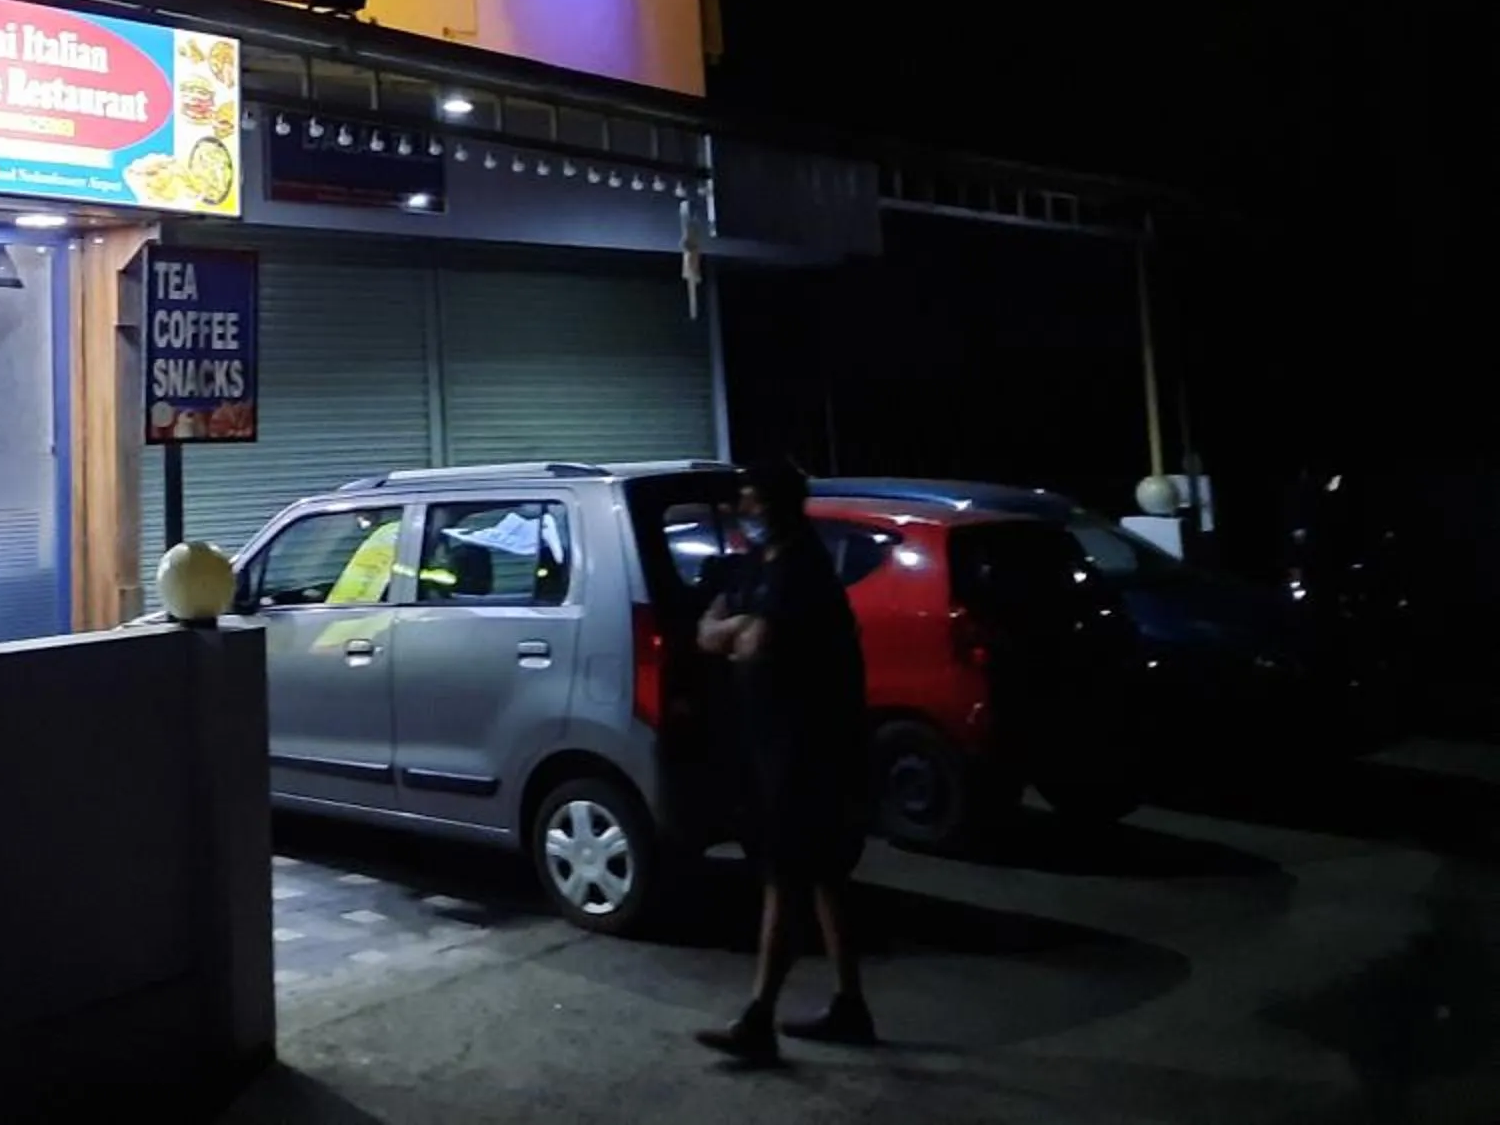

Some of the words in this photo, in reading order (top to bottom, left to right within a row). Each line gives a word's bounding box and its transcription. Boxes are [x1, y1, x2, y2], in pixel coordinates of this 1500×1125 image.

[23, 24, 108, 73] Italian
[6, 66, 148, 122] Restaurant
[153, 261, 198, 300] TEA
[153, 309, 240, 350] COFFEE
[152, 359, 244, 398] SNACKS
